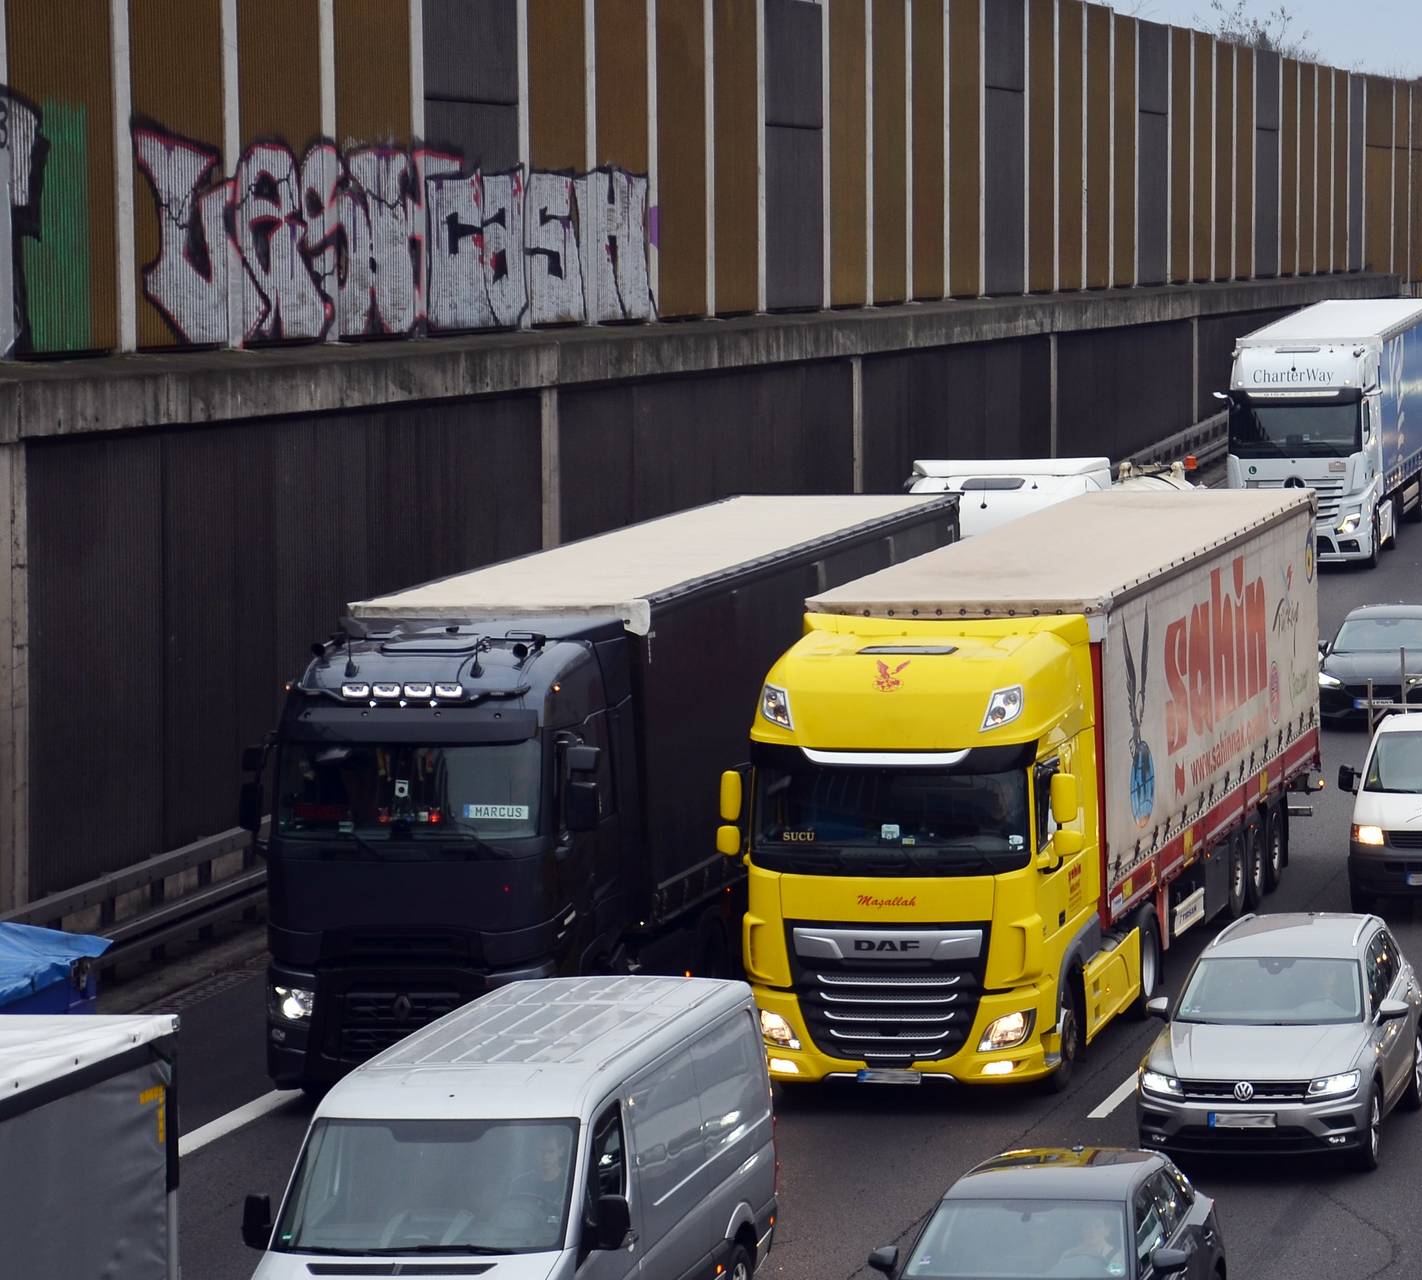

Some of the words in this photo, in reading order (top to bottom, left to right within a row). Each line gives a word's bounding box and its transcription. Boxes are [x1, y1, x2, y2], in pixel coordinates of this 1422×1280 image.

[1252, 367, 1335, 386] CharterWay
[474, 806, 523, 818] MARCUS
[853, 939, 920, 952] DAF
